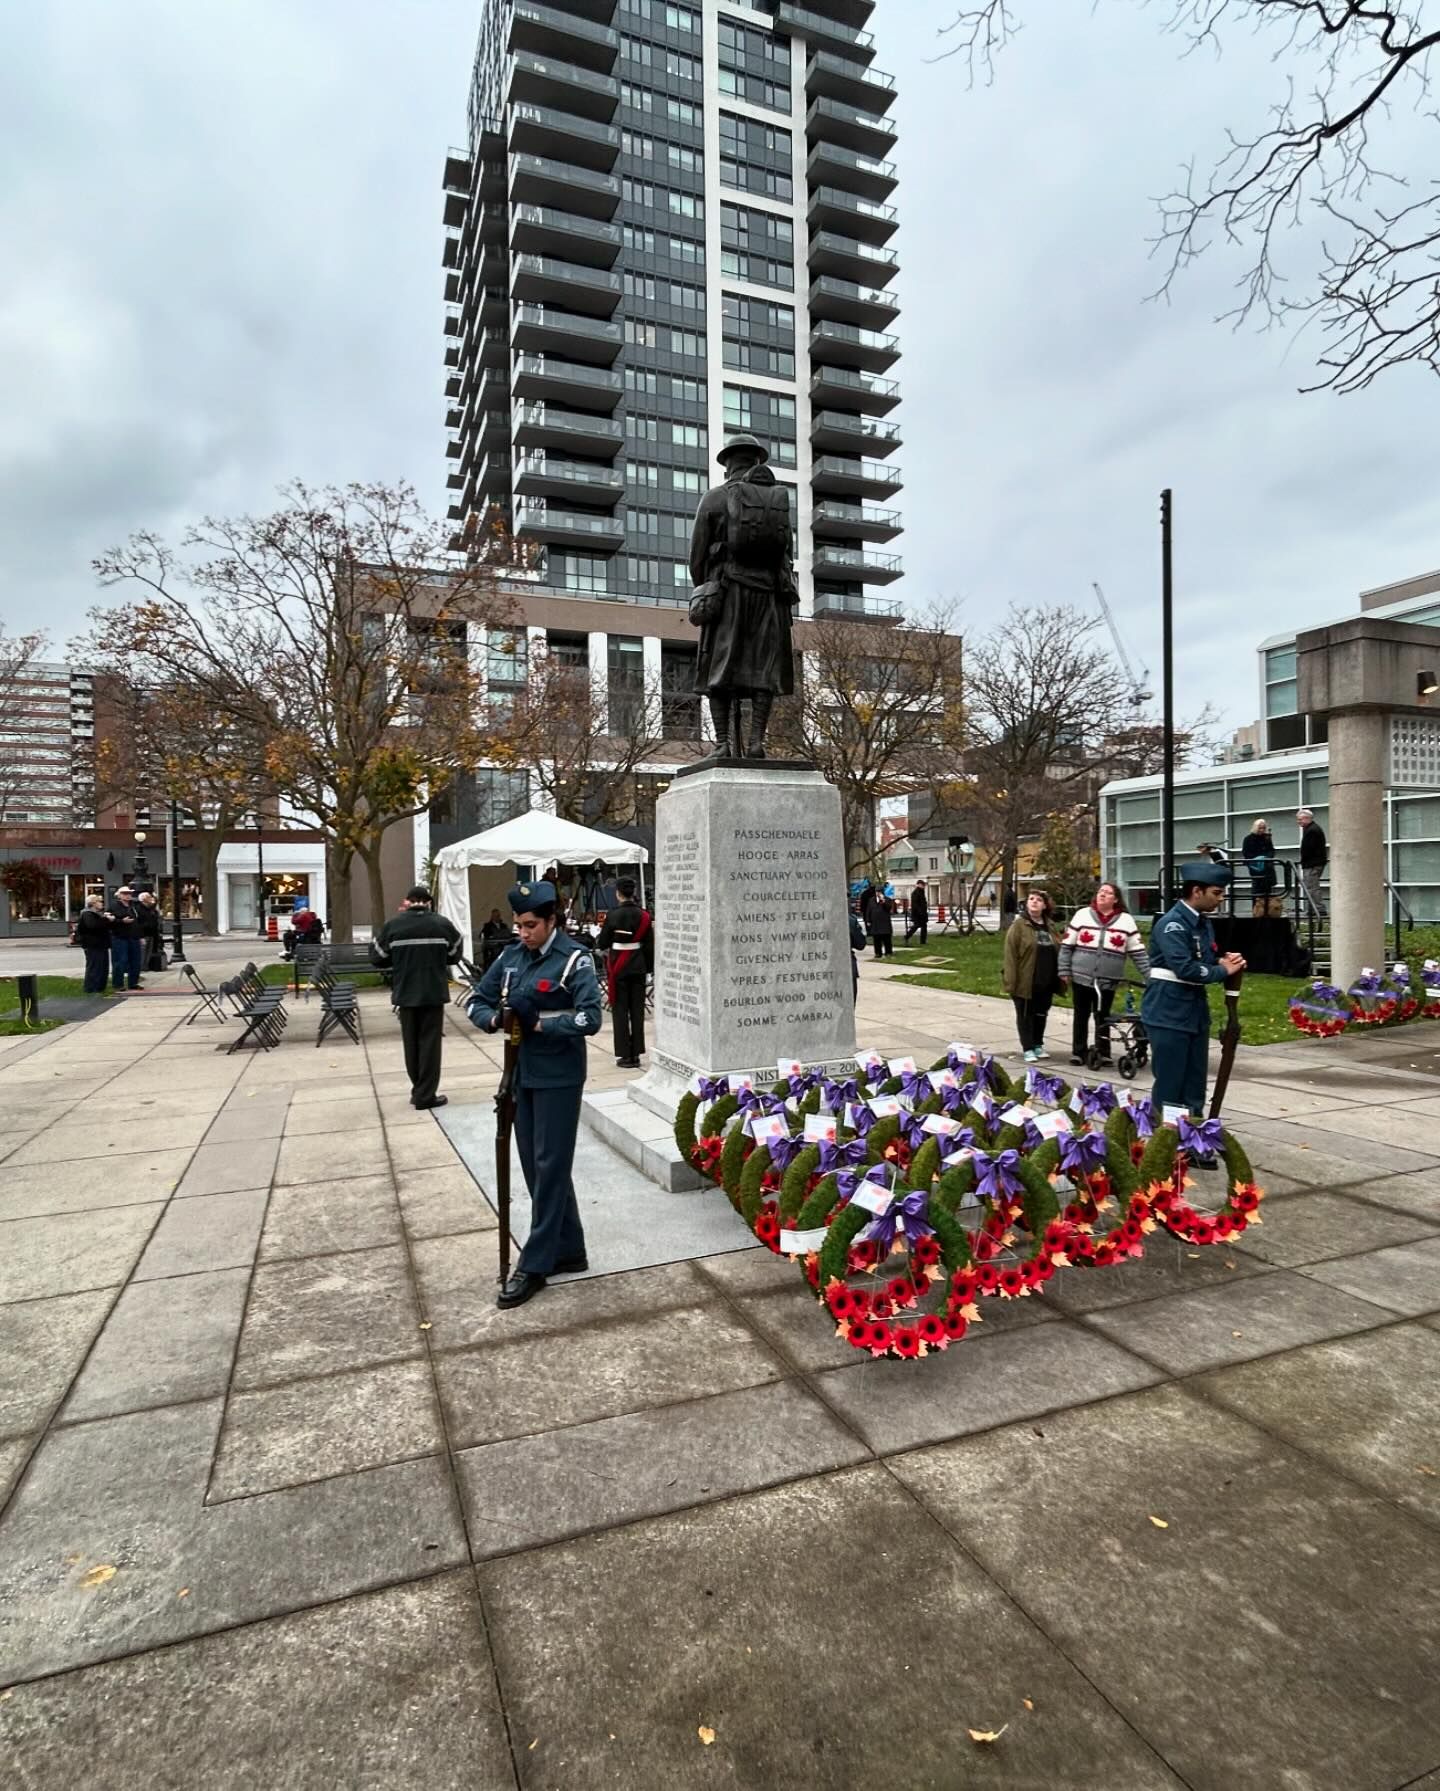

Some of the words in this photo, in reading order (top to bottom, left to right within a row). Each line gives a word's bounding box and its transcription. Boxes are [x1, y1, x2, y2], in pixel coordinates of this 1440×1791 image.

[734, 829, 821, 840] PASSCHENDAELE
[786, 850, 819, 860] ARRAS
[729, 871, 791, 881] SANCTUARY
[795, 871, 829, 881] WOOD
[743, 891, 817, 901] COURCELETTE
[735, 912, 776, 923] AMIENS
[801, 910, 825, 920] ELOI
[730, 933, 763, 944] MONS
[771, 932, 797, 942] VIMY
[800, 930, 831, 941] RIDGE
[736, 952, 793, 965] GIVENCHY
[802, 951, 828, 961] LENS
[730, 975, 767, 986] YPRES
[776, 971, 834, 983] FESTUBERT
[723, 996, 771, 1008] BOURLON
[774, 993, 806, 1004] WOOD
[813, 991, 843, 1001] DOUAI
[737, 1015, 777, 1028] SOMME
[786, 1011, 833, 1024] CAMBRAI
[840, 1062, 859, 1073] 201
